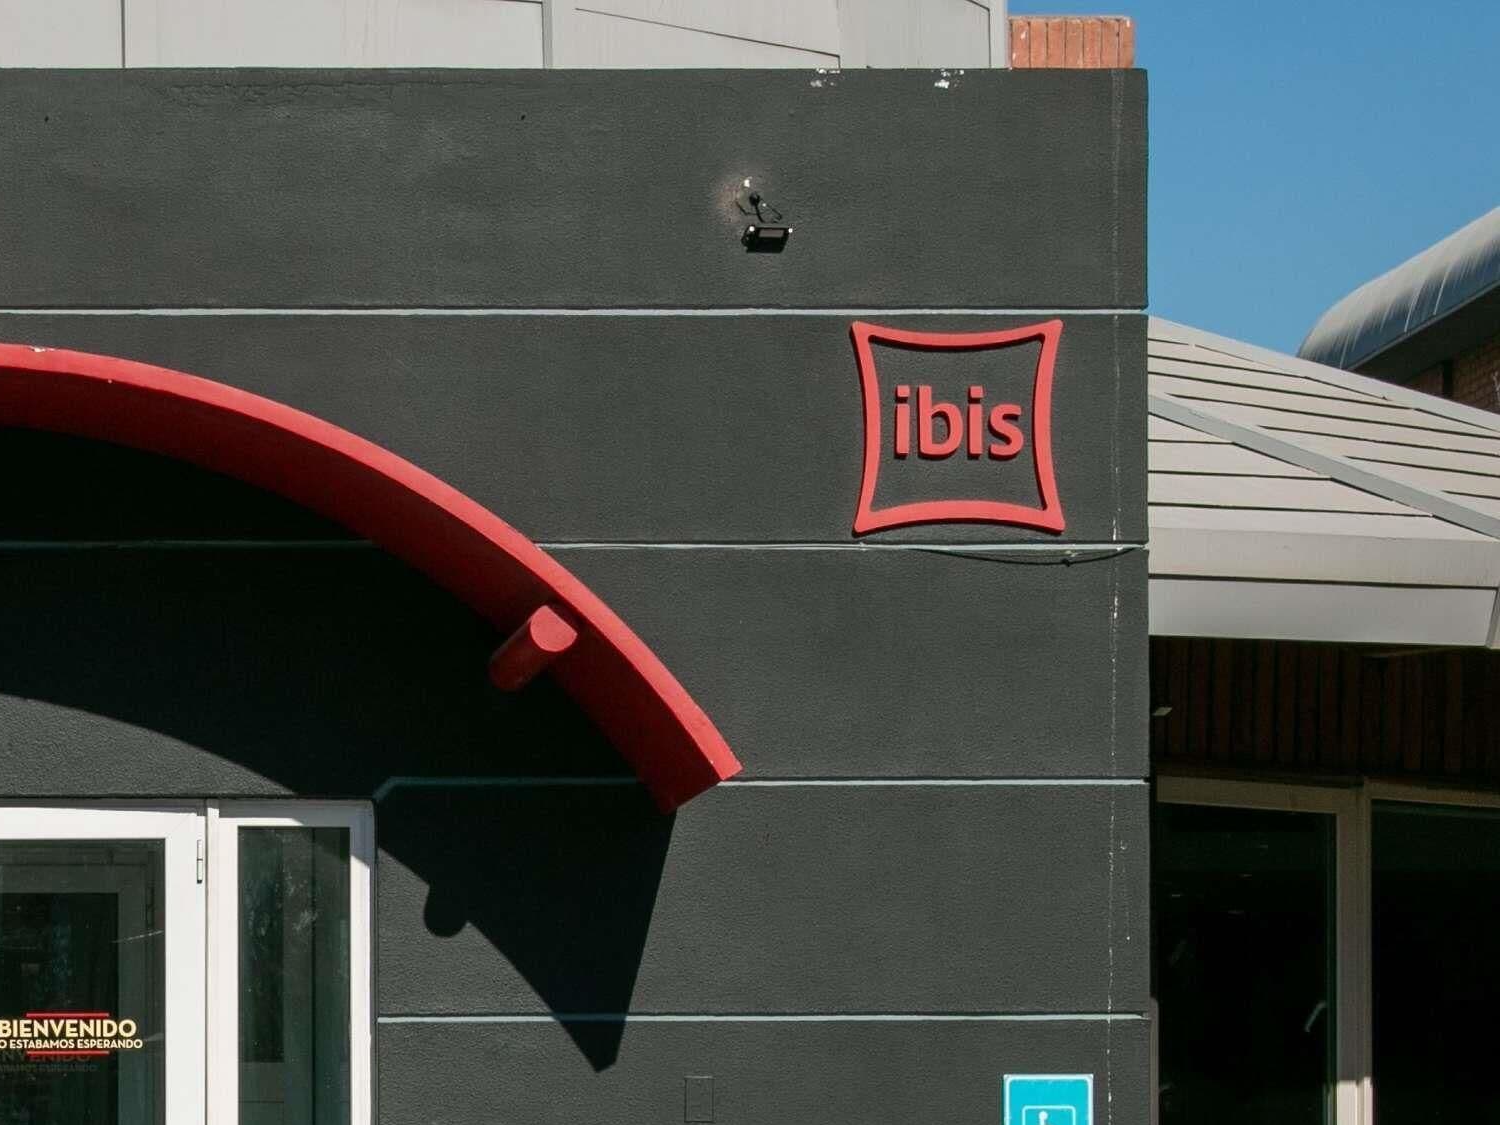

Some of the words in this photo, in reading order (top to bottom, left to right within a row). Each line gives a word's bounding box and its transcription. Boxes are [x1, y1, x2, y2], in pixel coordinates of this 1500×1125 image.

[894, 384, 1024, 461] ibis
[9, 1039, 75, 1049] ESTABAMOS
[77, 1039, 143, 1049] ESPERANDO
